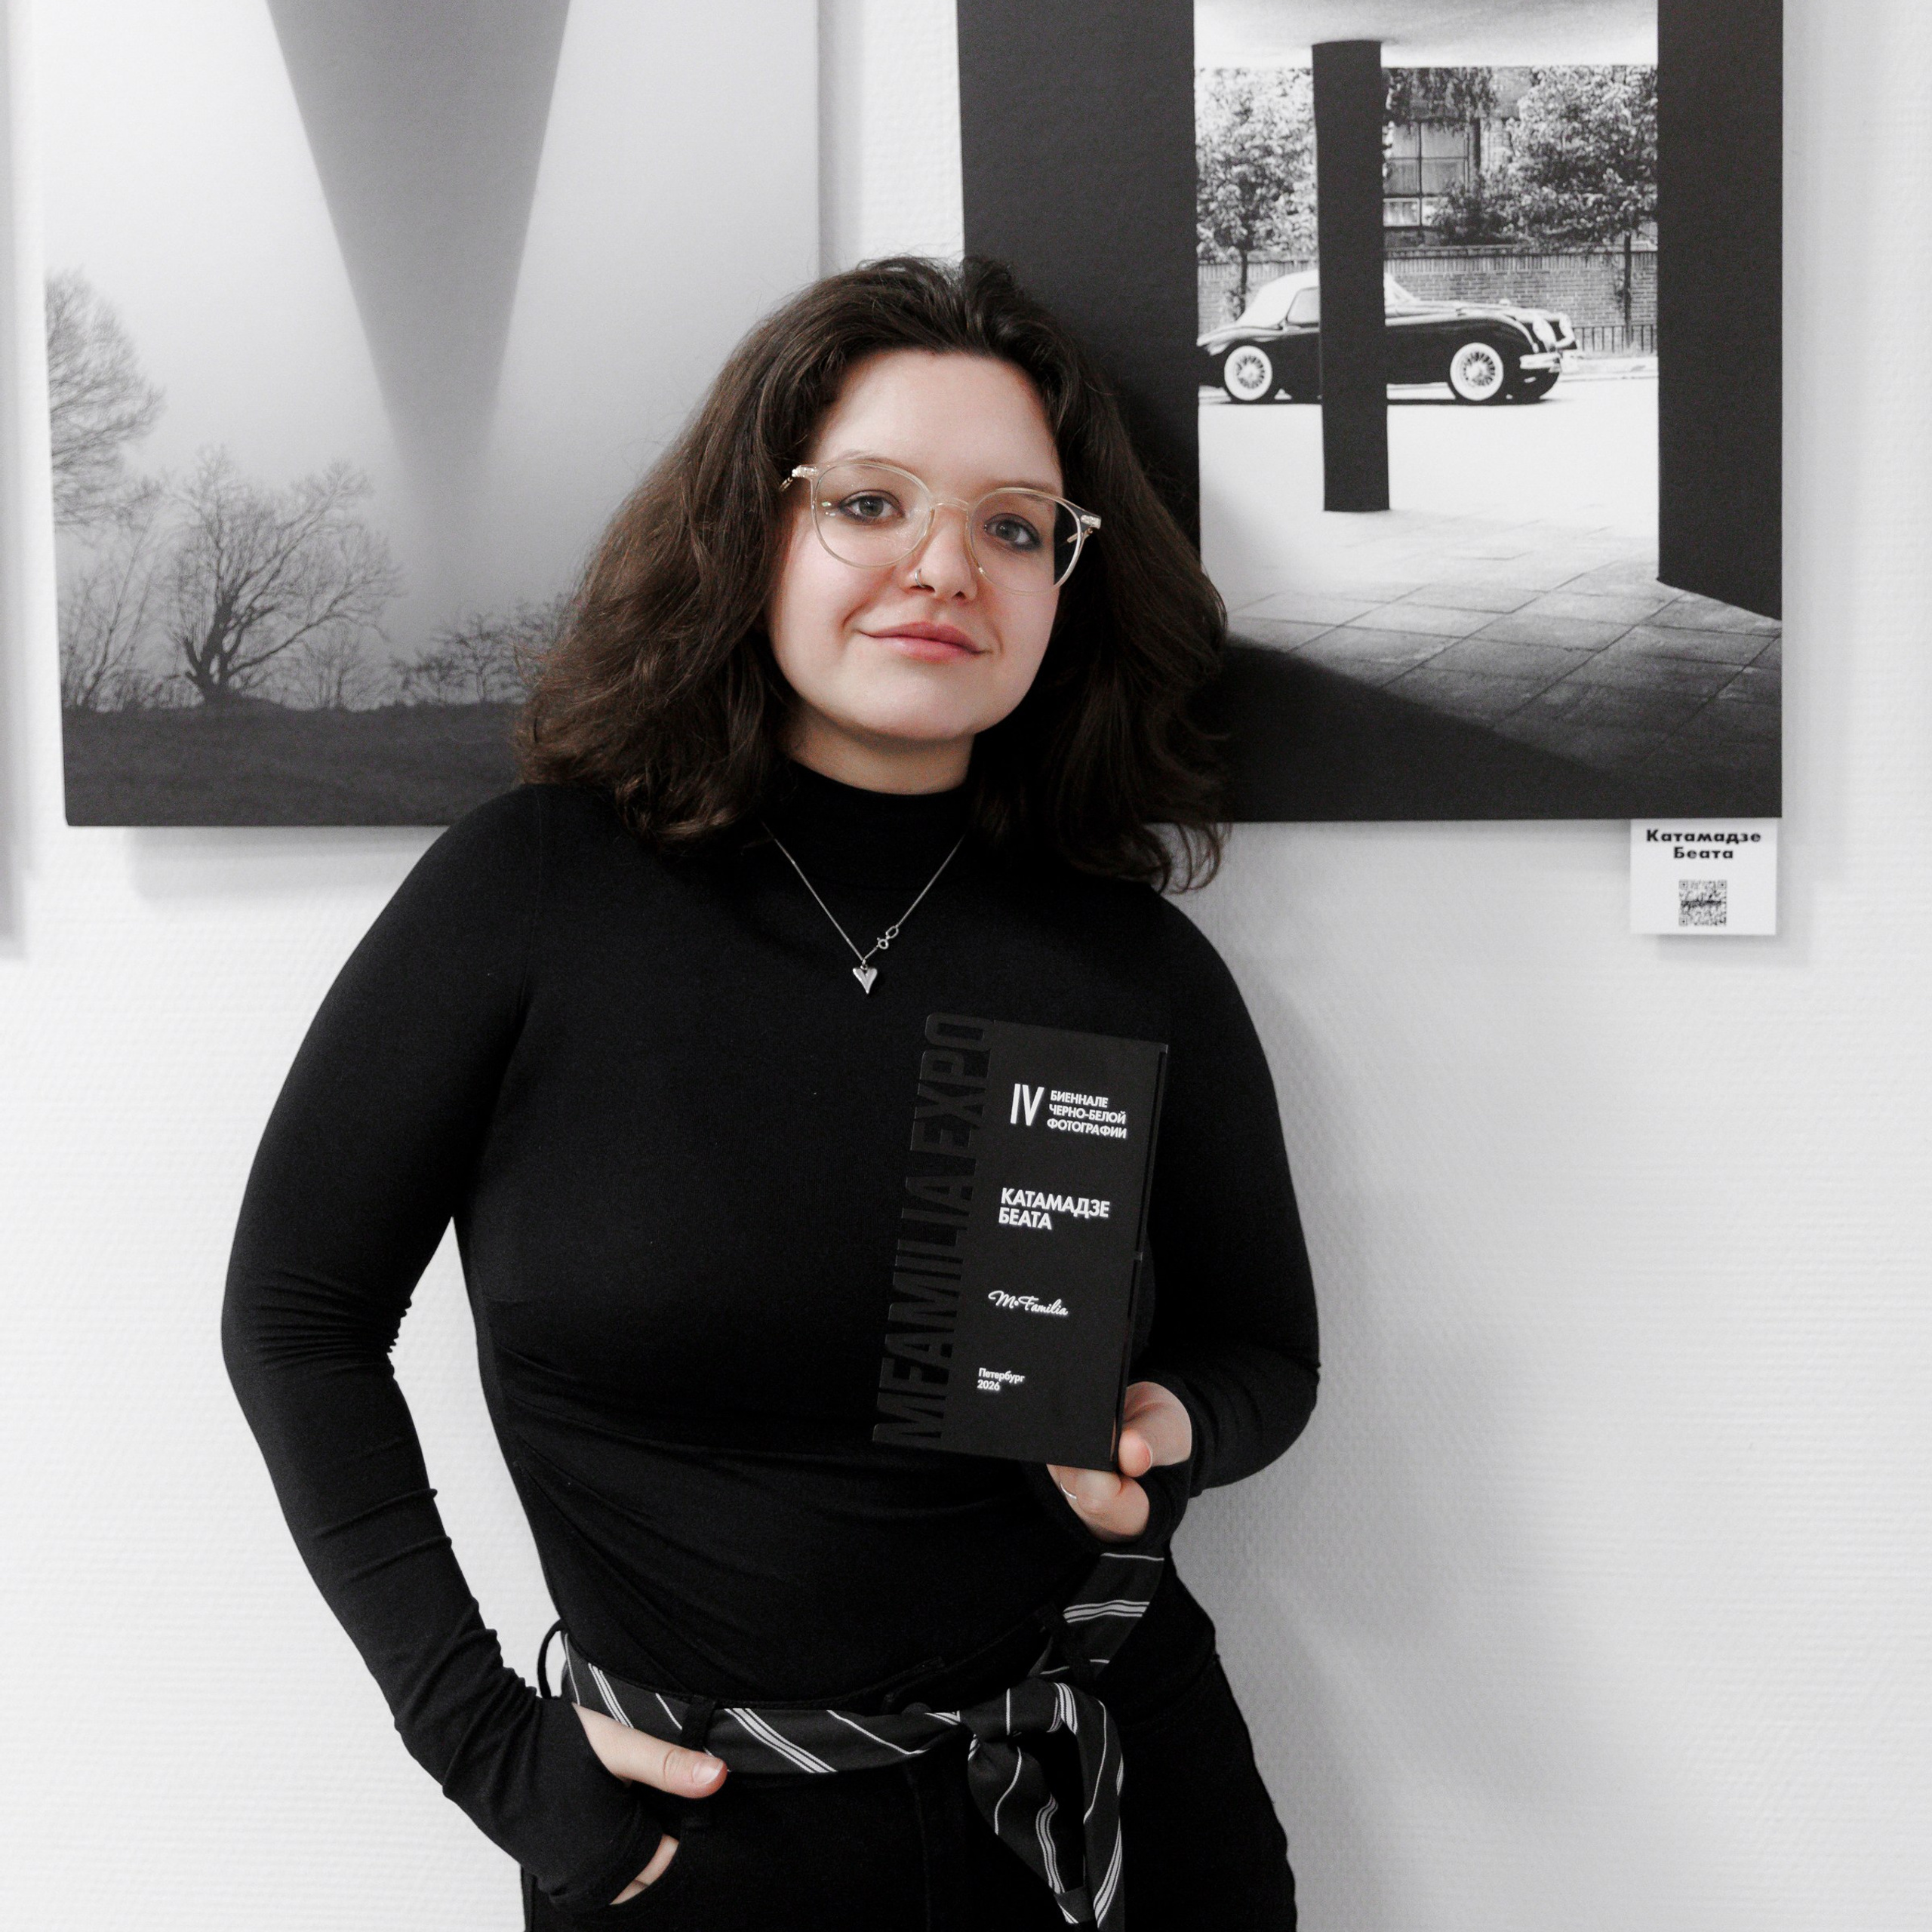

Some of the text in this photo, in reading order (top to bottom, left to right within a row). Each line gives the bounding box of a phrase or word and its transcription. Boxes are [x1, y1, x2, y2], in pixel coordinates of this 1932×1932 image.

[1647, 829, 1761, 844] Катамадзе
[1674, 847, 1734, 859] Беата
[1010, 1083, 1045, 1127] IV
[1050, 1090, 1109, 1108] БИЕННАЛЕ
[1048, 1103, 1127, 1124] ЧЕРНО-БЕЛОЙ
[1047, 1118, 1128, 1139] ФОТОГРАФИИ
[1001, 1187, 1110, 1219] КАТАМАДЗЕ
[998, 1207, 1052, 1230] БЕАТА
[977, 1379, 1000, 1391] 2026
[979, 1367, 1025, 1384] Петербург
